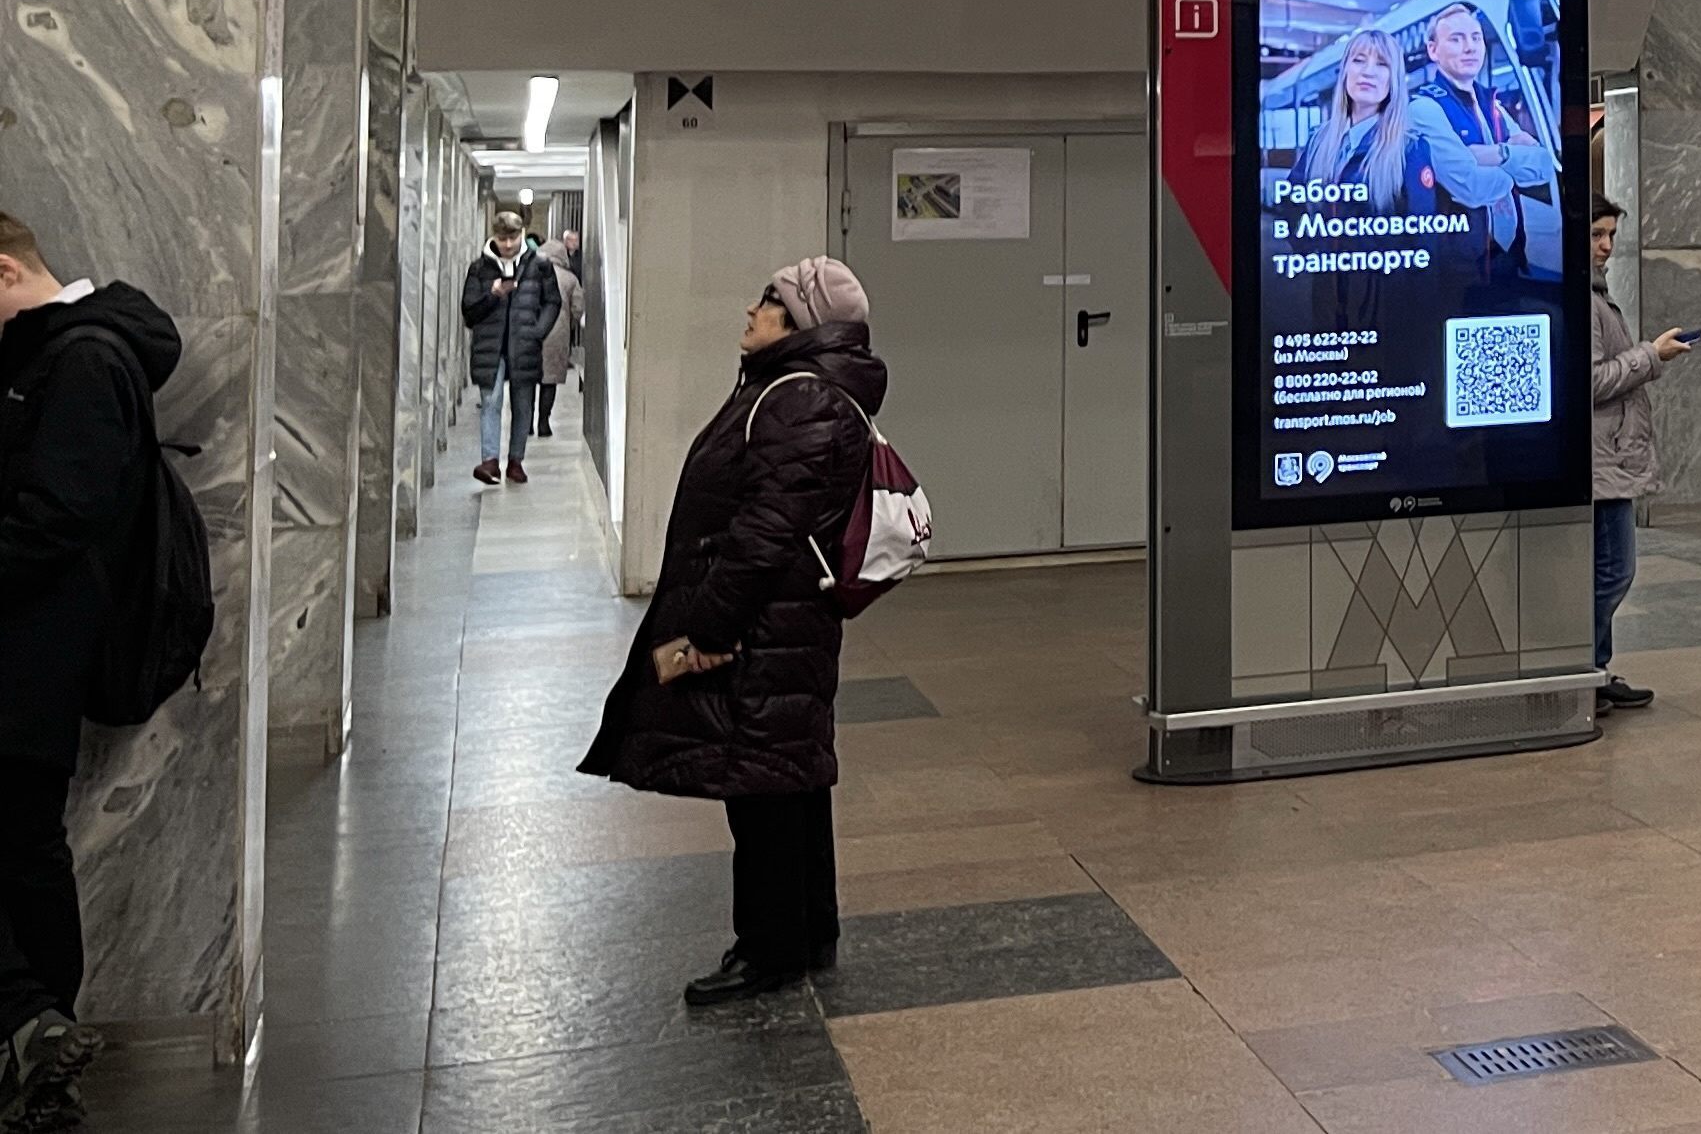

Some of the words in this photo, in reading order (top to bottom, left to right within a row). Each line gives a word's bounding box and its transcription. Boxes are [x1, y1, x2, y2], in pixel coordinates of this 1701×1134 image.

[682, 117, 698, 129] 60
[1274, 179, 1368, 204] Работа
[1274, 220, 1289, 238] в
[1296, 213, 1470, 238] Московском
[1273, 249, 1430, 278] транспорте
[1274, 334, 1283, 349] 8
[1285, 333, 1311, 347] 495
[1314, 331, 1377, 346] 622-22-22
[1274, 349, 1293, 364] (из
[1294, 347, 1349, 363] Москвы)
[1274, 375, 1283, 388] 8
[1286, 373, 1312, 388] 800
[1313, 371, 1378, 386] 220-22-02
[1274, 387, 1341, 405] (бесплатно
[1343, 388, 1365, 402] для
[1367, 382, 1425, 401] регионов)
[1274, 409, 1396, 429] transport.mos.ru/job
